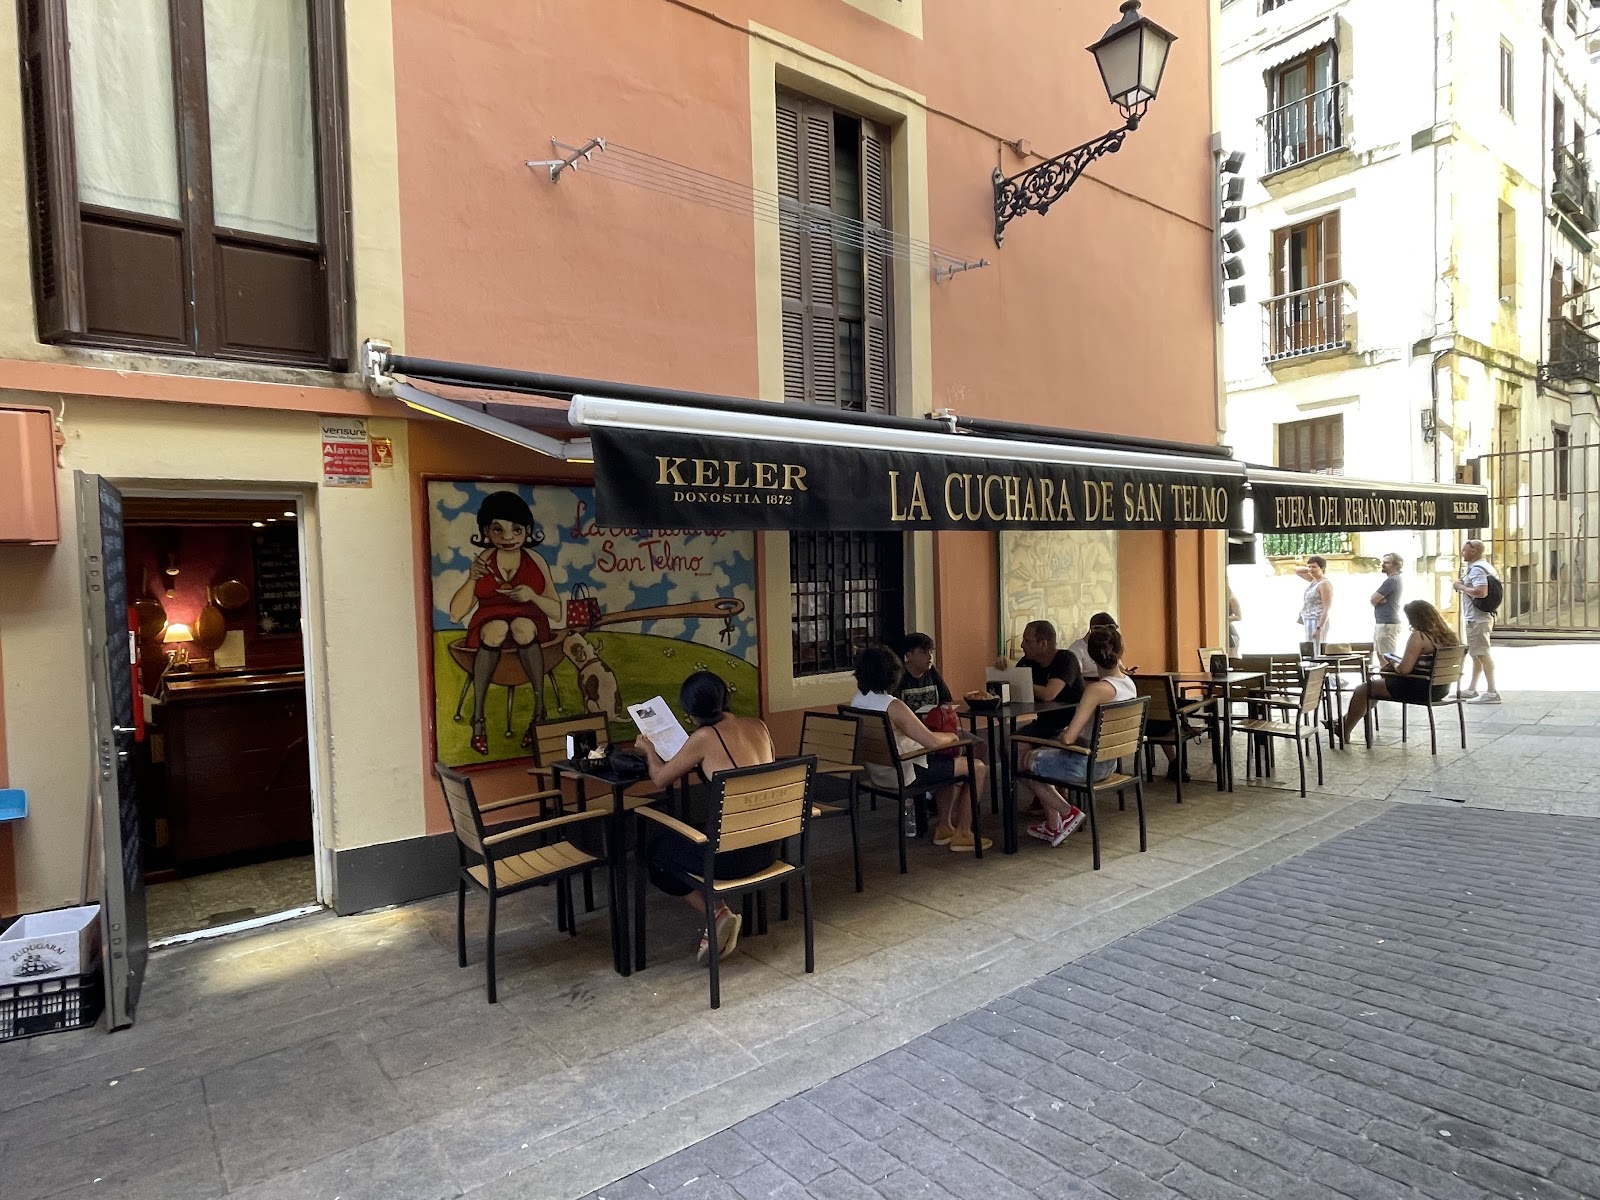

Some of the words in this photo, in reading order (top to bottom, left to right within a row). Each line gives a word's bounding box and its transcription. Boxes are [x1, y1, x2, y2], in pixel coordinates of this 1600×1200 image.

[324, 444, 368, 454] Alarma
[654, 455, 808, 491] KELER
[674, 492, 761, 505] DONOSTIA
[766, 495, 793, 506] 1872
[889, 471, 932, 521] LA
[944, 472, 1076, 521] CUCHARA
[1083, 480, 1115, 522] DE
[1123, 482, 1163, 522] SAN
[1171, 484, 1228, 523] TELMO
[1275, 496, 1316, 528] FUERA
[1319, 496, 1341, 526] DEL
[1345, 491, 1386, 526] REBAÑO
[1389, 498, 1418, 526] DESDE
[1420, 500, 1437, 526] 1999
[1453, 502, 1479, 514] KELER
[598, 540, 646, 573] San
[639, 540, 703, 572] Telmo
[10, 943, 66, 961] ZUDUGARAI
